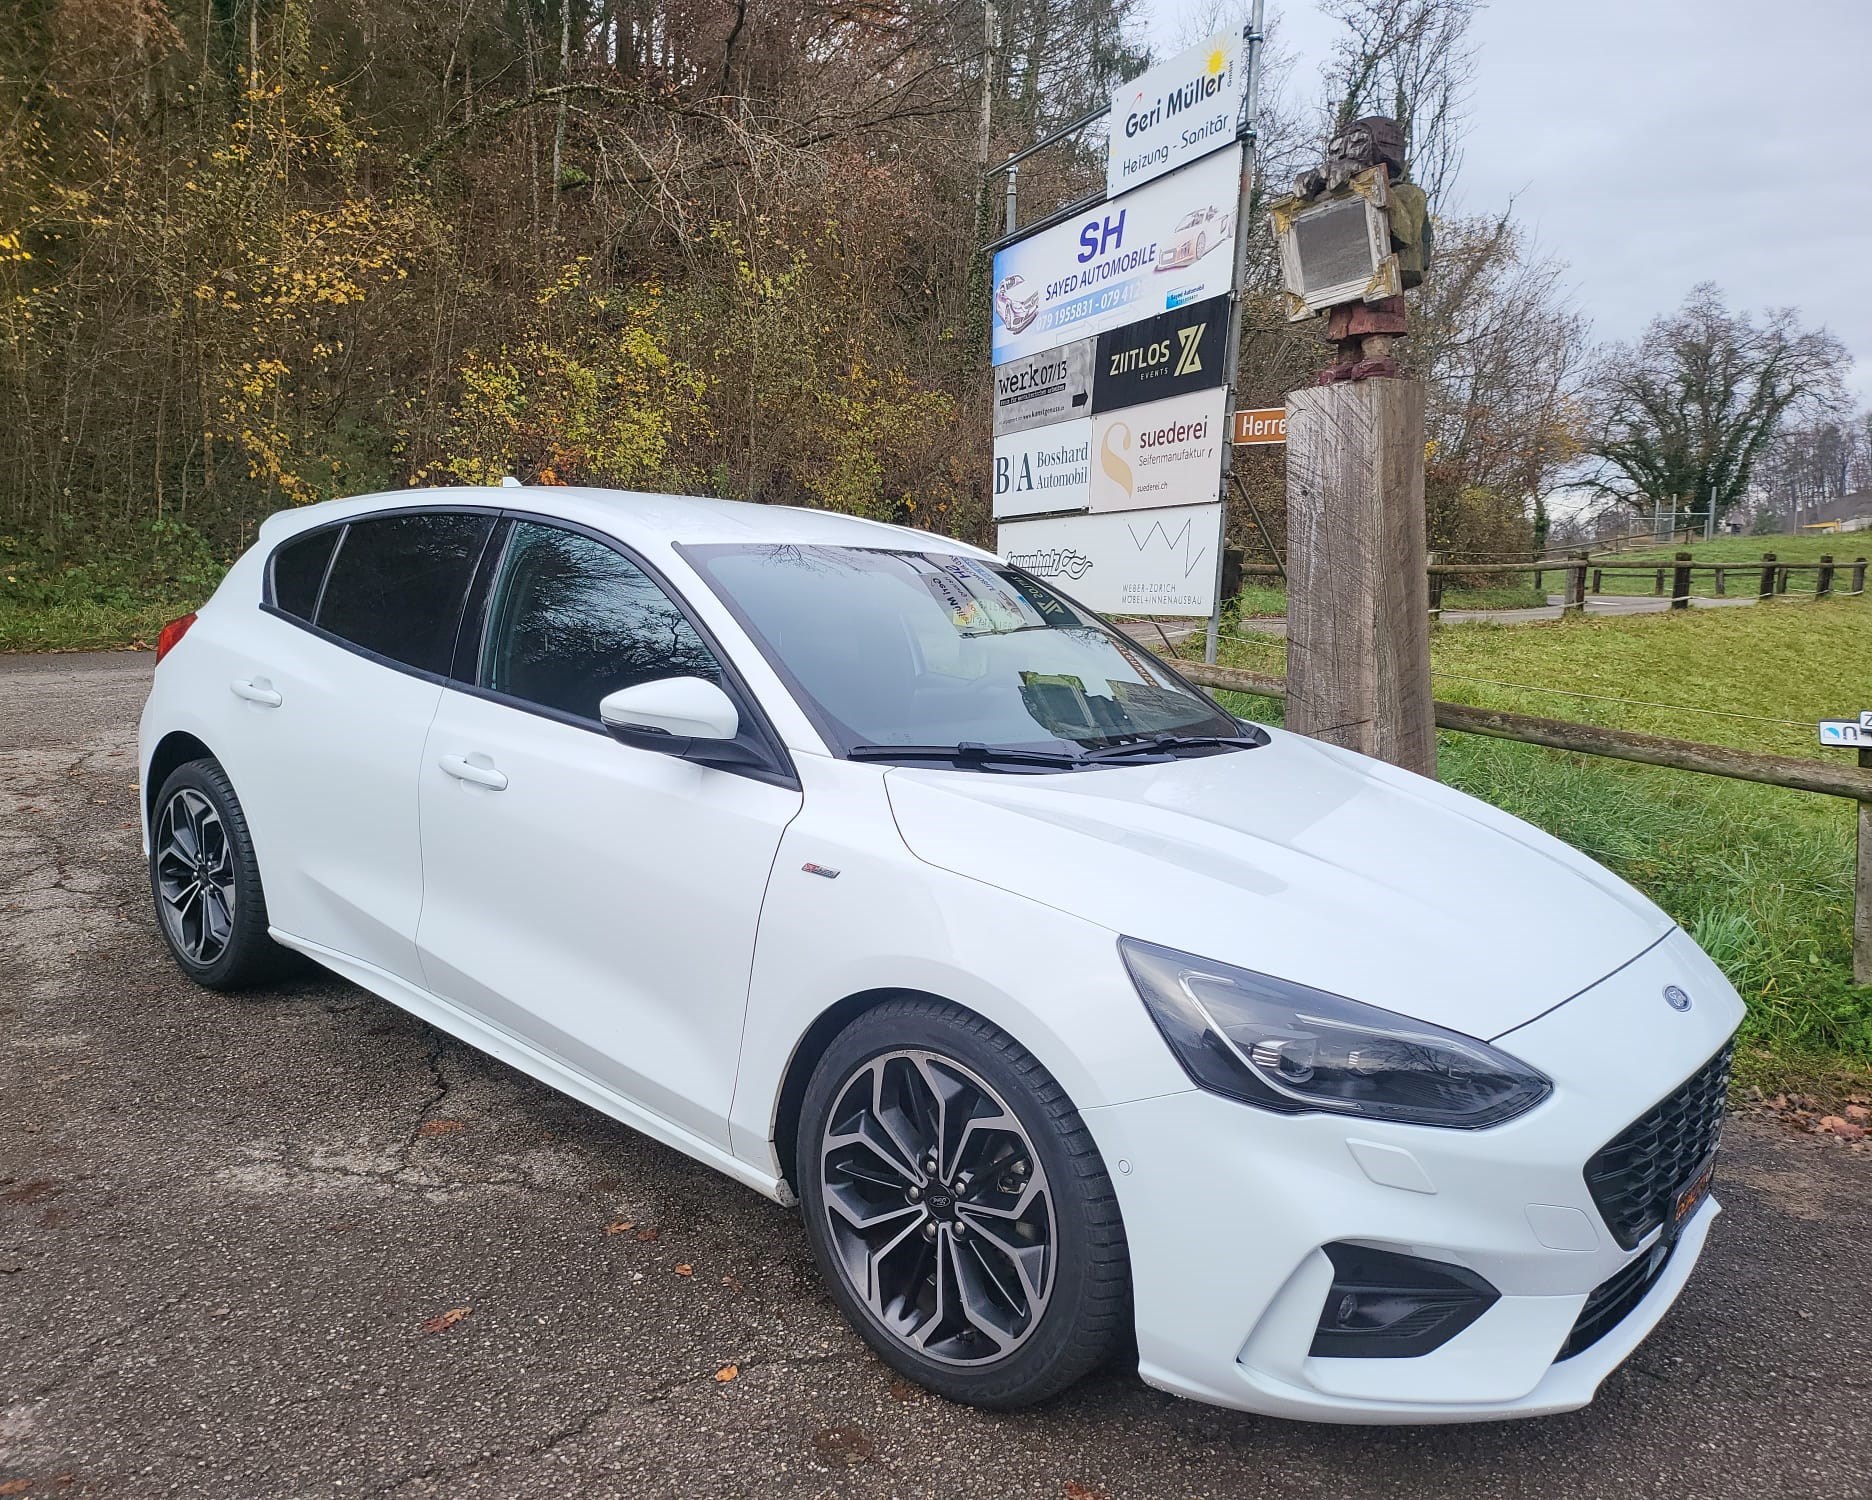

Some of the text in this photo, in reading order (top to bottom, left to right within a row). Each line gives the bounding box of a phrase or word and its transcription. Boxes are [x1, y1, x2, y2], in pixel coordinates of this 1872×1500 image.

[1126, 72, 1225, 138] Geri Müller
[1123, 145, 1169, 177] Heizung
[1181, 114, 1229, 149] Sanitär
[1078, 208, 1126, 263] SH
[1046, 243, 1157, 301] SAYED AUTOMOBILE
[1054, 299, 1094, 326] 1955831
[1101, 288, 1120, 310] 079
[1109, 339, 1170, 376] ZIITLOS
[1140, 367, 1169, 380] EVENTS
[998, 360, 1067, 395] werk 07/13
[1139, 415, 1208, 449] suederei
[1036, 442, 1088, 468] Bosshard
[1138, 447, 1206, 467] Seifenmanufaktur
[1036, 466, 1088, 490] Automobil
[1137, 480, 1168, 493] suederei.ch
